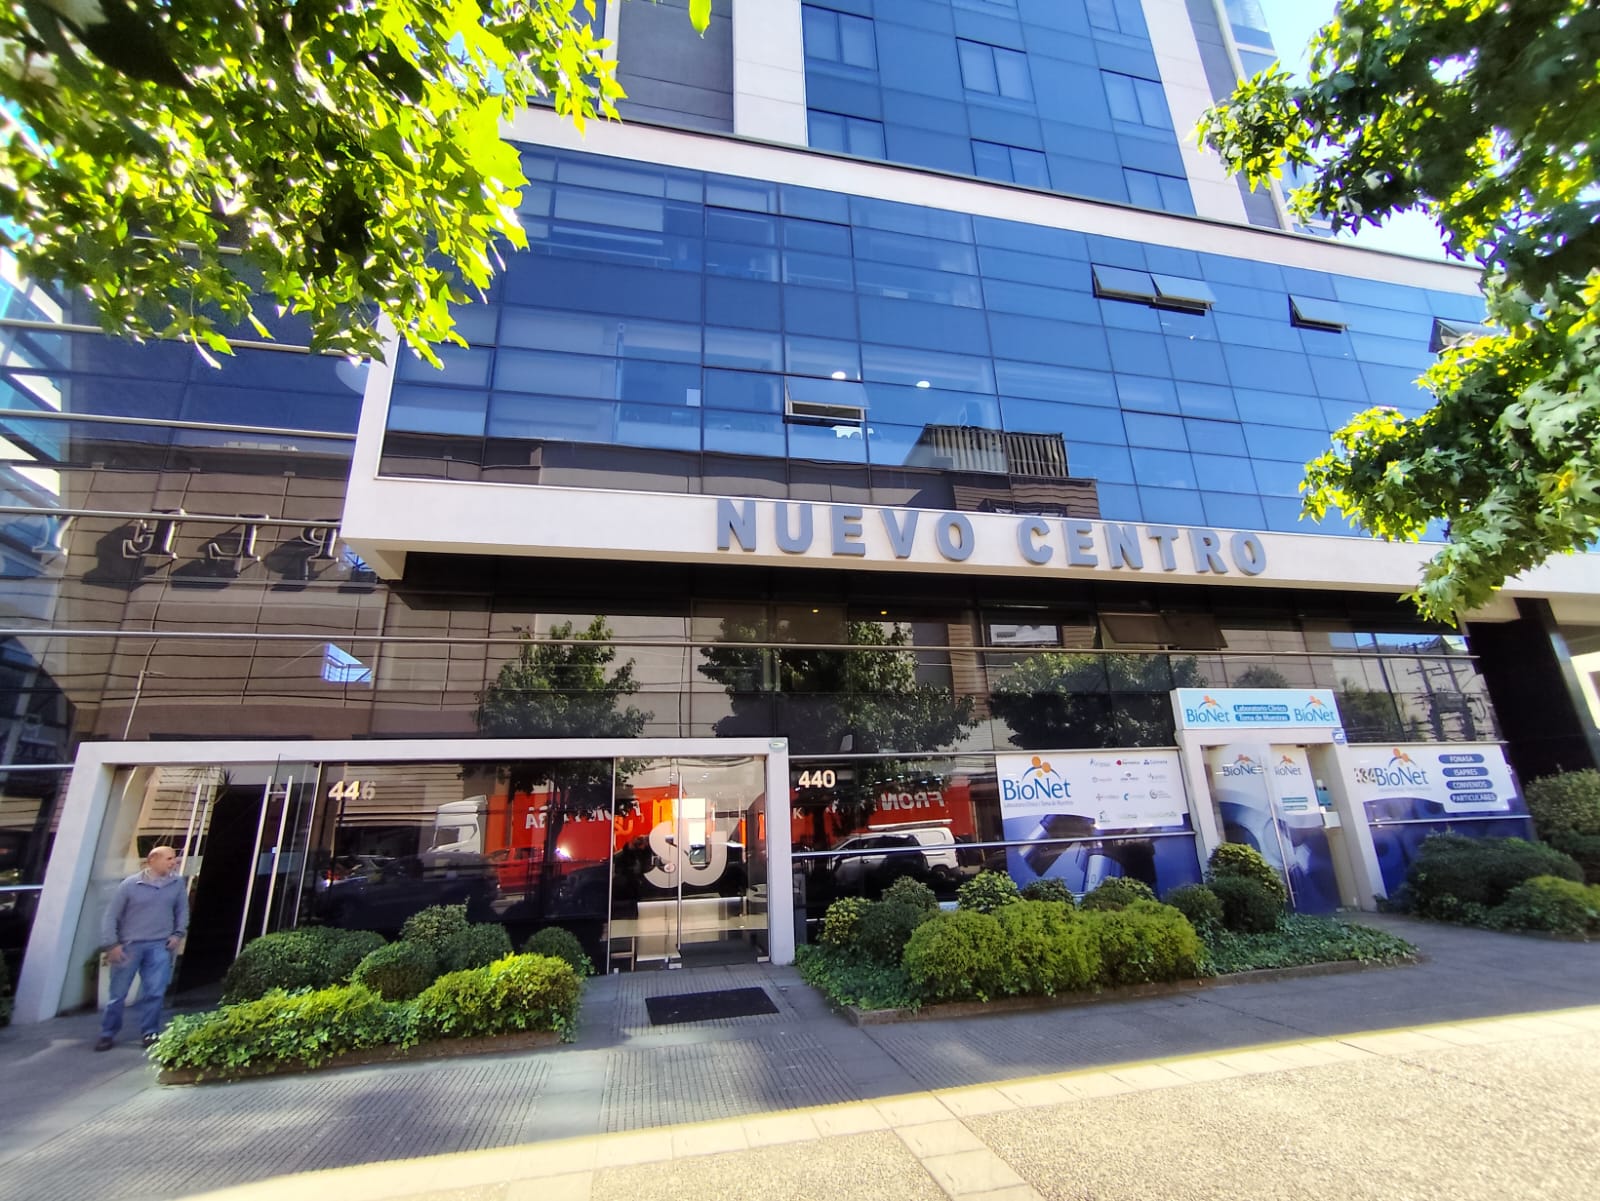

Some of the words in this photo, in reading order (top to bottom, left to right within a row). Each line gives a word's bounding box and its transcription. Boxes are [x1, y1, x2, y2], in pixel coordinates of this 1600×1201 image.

[717, 498, 975, 562] NUEVO
[1017, 516, 1267, 576] CENTRO
[1186, 708, 1230, 723] BioNet
[1294, 708, 1336, 723] BioNet
[798, 770, 836, 788] 440
[1375, 767, 1429, 786] BioNet
[328, 780, 377, 801] 446
[1002, 777, 1072, 801] BioNet
